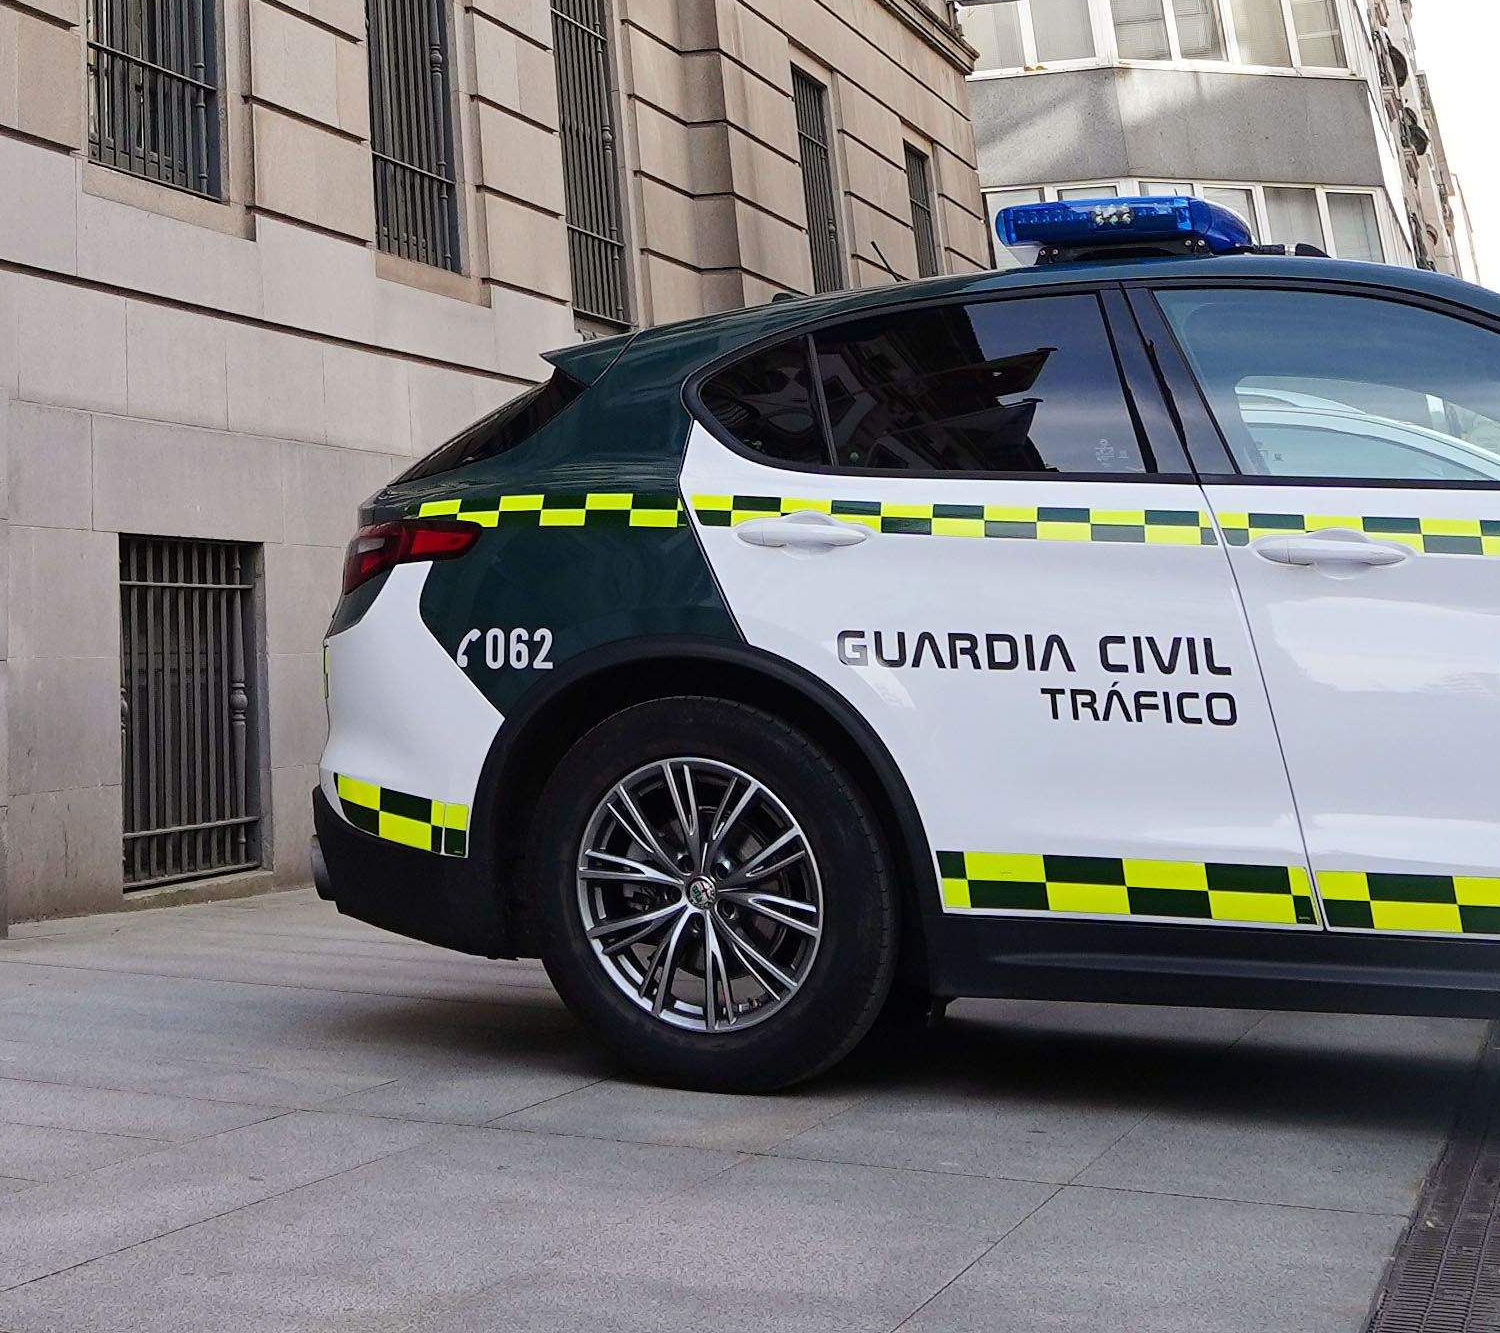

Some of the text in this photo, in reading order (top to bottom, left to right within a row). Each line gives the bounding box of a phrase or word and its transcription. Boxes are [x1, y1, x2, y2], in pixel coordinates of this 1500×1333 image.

[485, 627, 554, 670] 062
[837, 630, 1232, 676] GUARDIA CIVIL
[1040, 681, 1238, 726] TRÁFICO
